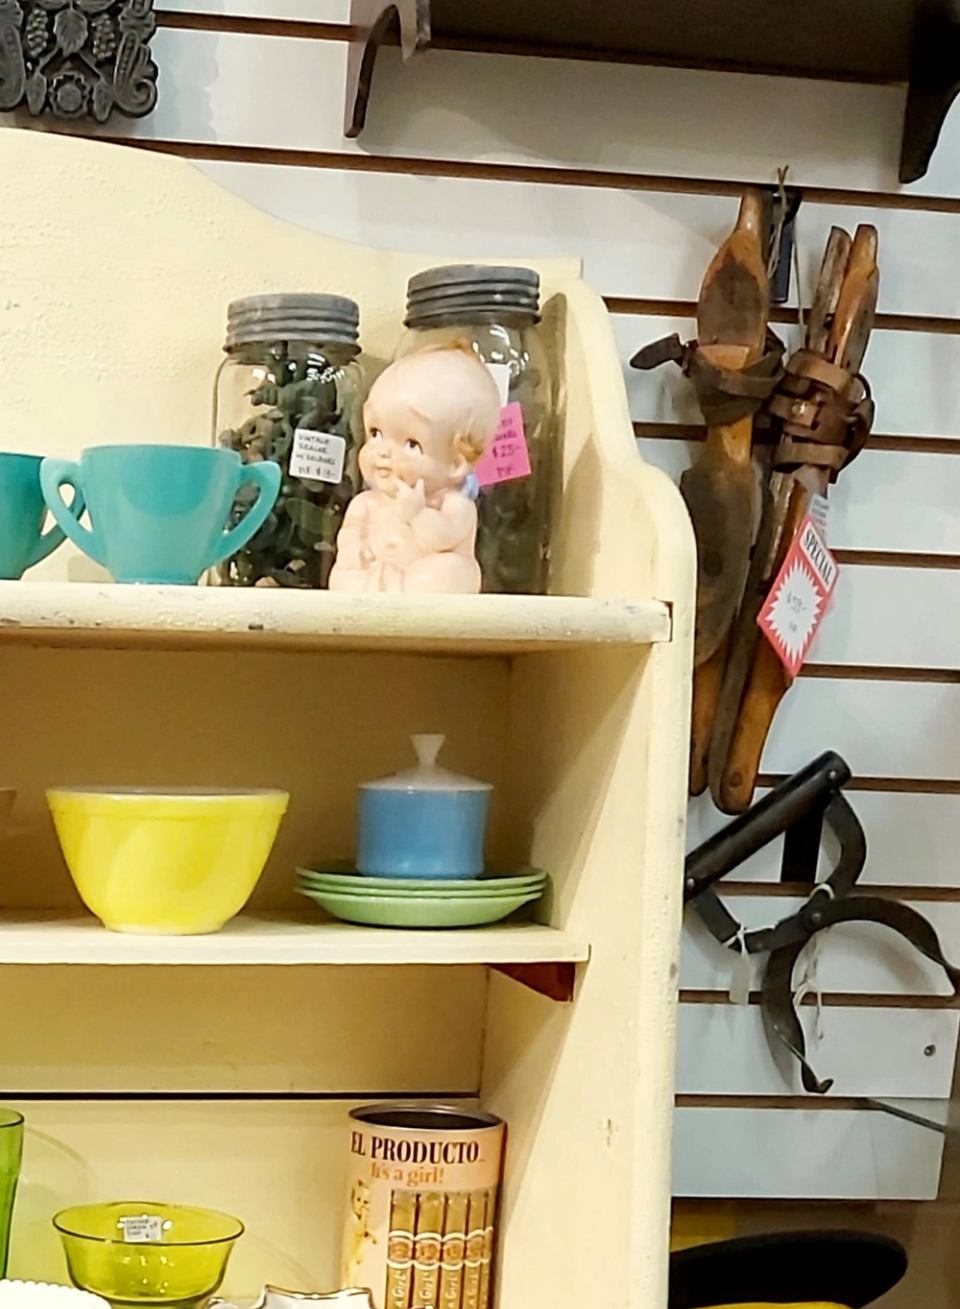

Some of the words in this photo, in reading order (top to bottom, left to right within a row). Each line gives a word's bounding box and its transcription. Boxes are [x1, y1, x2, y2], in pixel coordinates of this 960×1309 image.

[805, 528, 833, 586] SPECIAL
[351, 1131, 366, 1156] EL
[371, 1136, 480, 1165] PRODUCTO
[371, 1161, 390, 1180] It's
[394, 1168, 403, 1181] a
[406, 1166, 444, 1187] girl!
